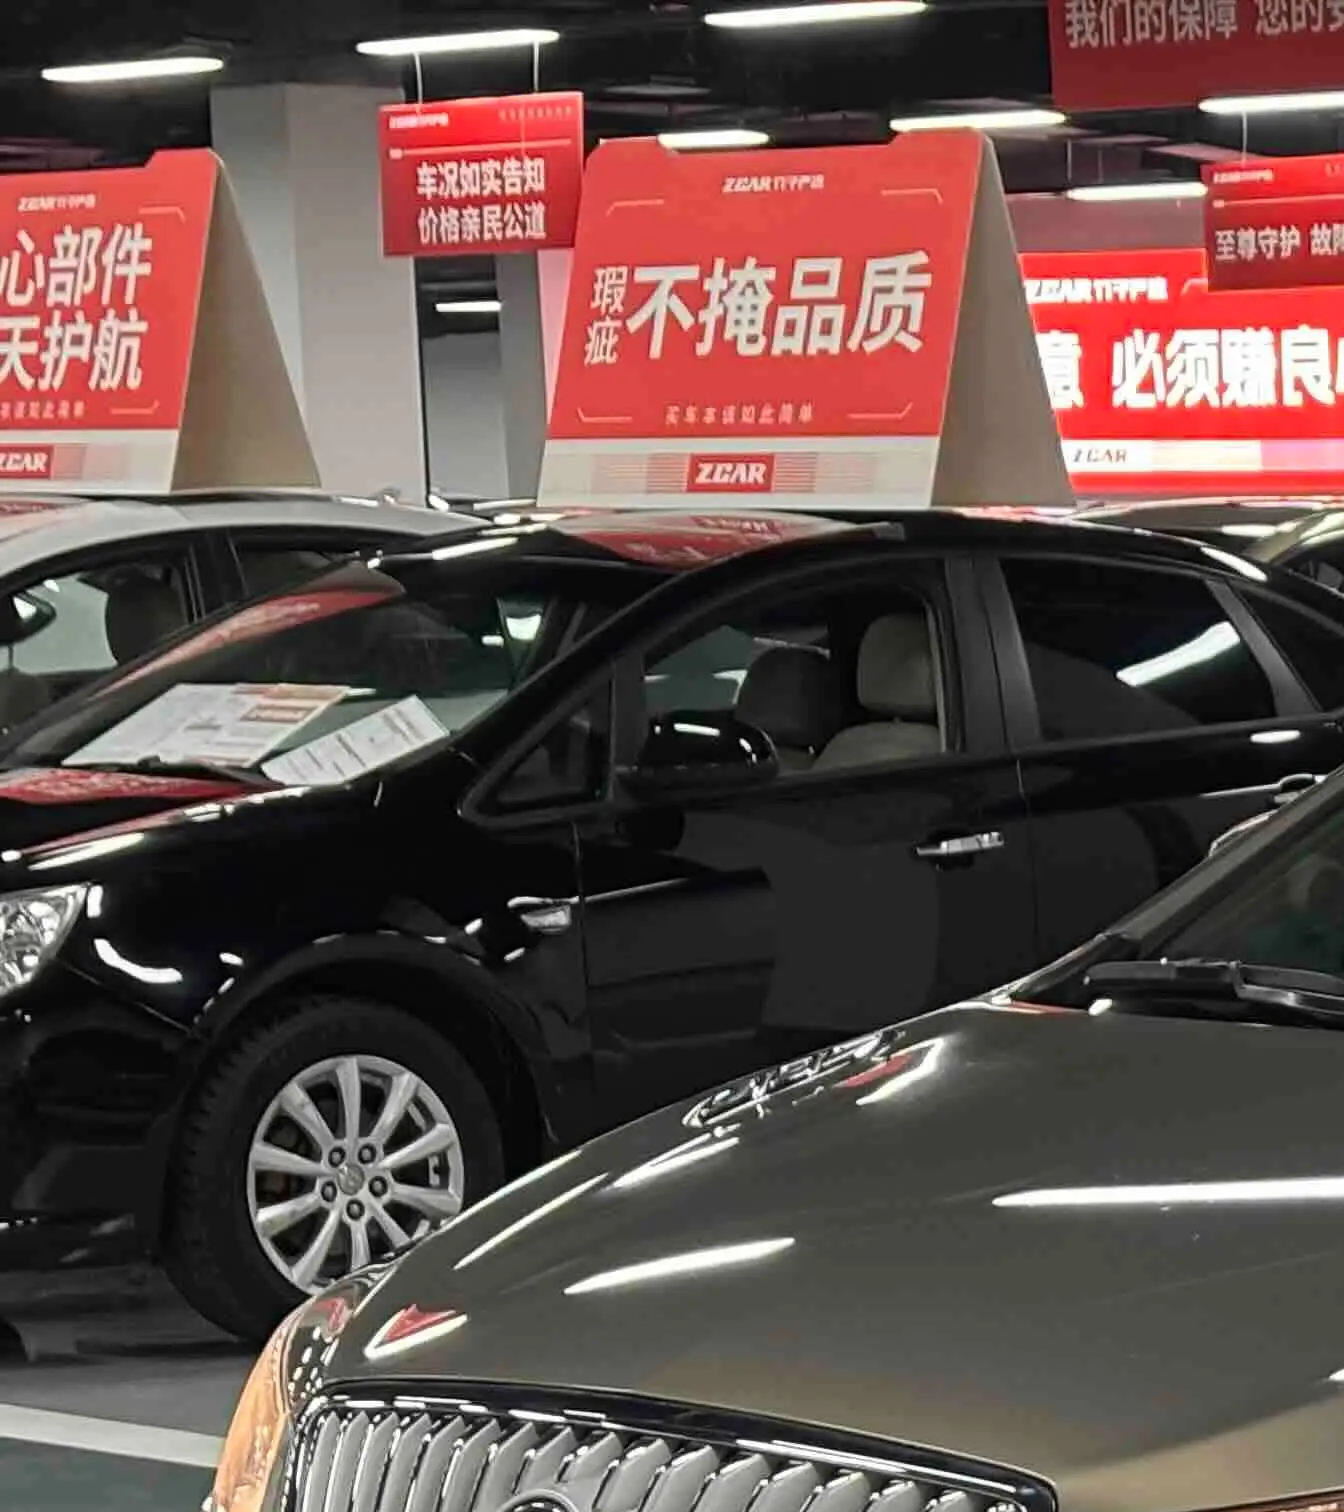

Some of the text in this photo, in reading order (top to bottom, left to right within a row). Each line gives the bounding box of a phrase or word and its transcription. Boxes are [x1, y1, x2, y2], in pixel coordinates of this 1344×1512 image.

[1066, 0, 1238, 48] 我们的保障
[417, 157, 545, 200] 车况如实告知
[418, 202, 547, 245] 价格亲民公道
[1215, 224, 1301, 262] 至尊守护
[585, 265, 628, 366] 瑕疵
[626, 250, 932, 360] 不掩品质
[0, 306, 149, 392] 天护航
[694, 462, 768, 485] ZCAR
